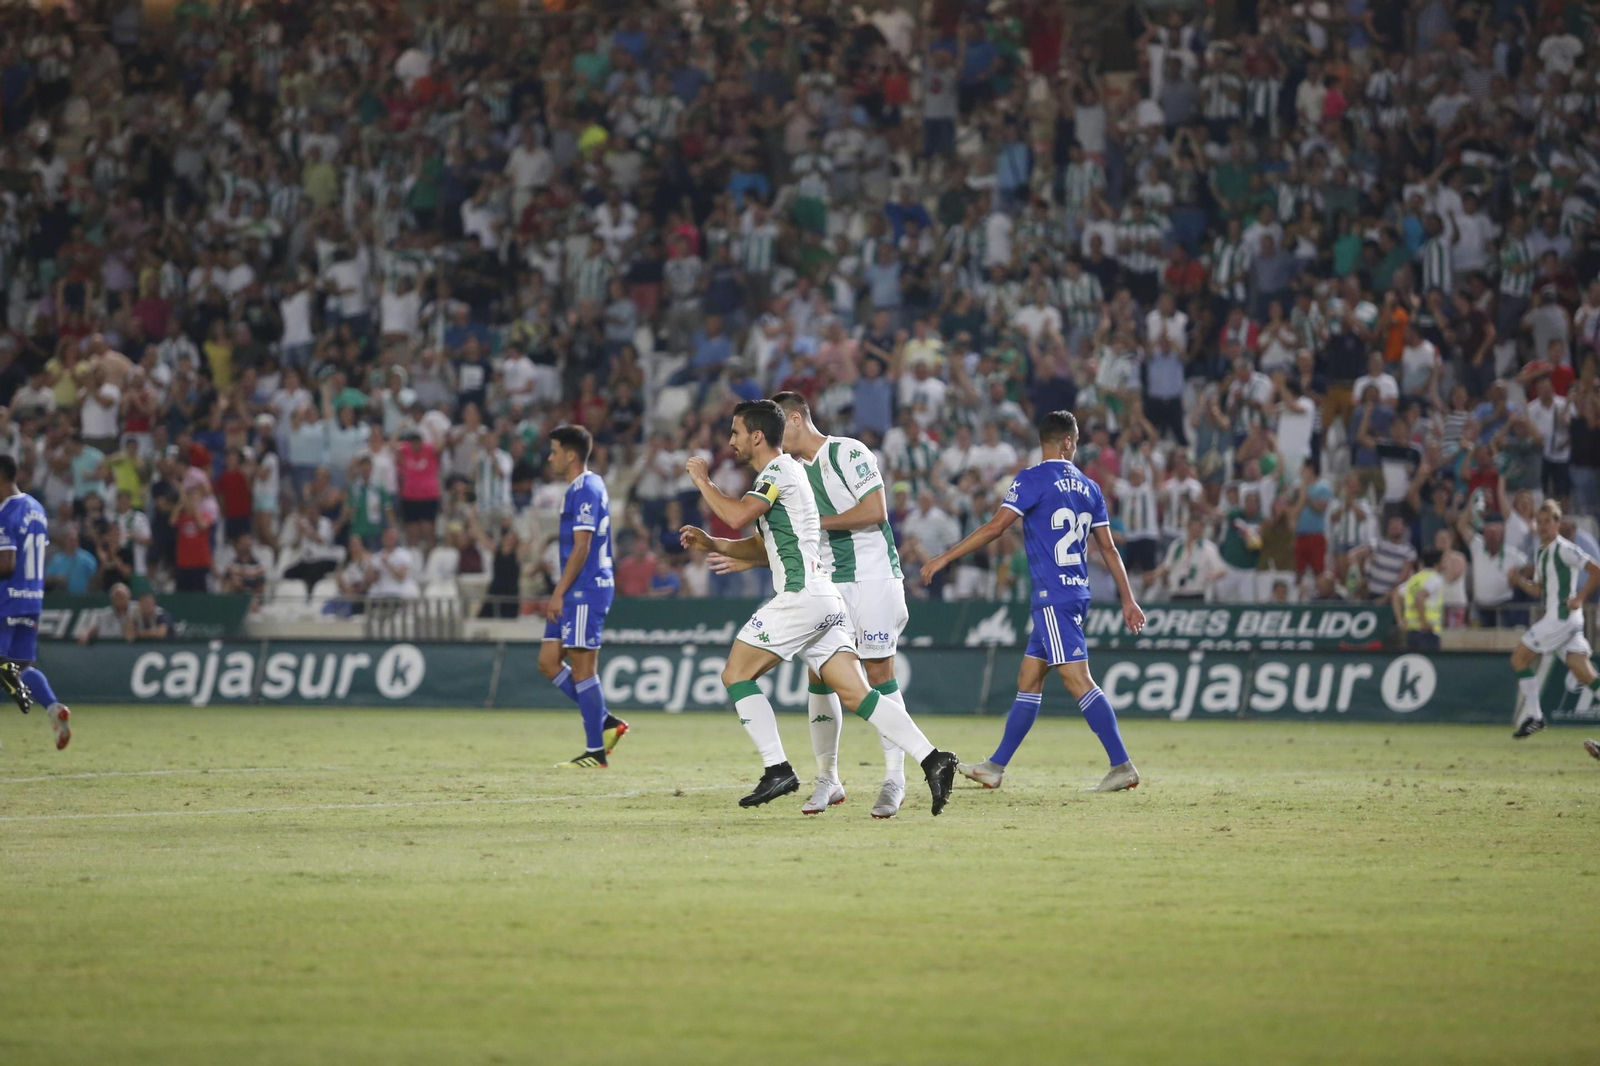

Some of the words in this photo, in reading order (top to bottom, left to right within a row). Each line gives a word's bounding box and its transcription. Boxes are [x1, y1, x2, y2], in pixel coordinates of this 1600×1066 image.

[1054, 478, 1090, 498] TEJERA
[23, 533, 46, 580] 11
[863, 630, 889, 641] forte
[1234, 610, 1378, 640] BELLIDO
[131, 640, 371, 707] cajasur
[1101, 650, 1373, 721] cajasur
